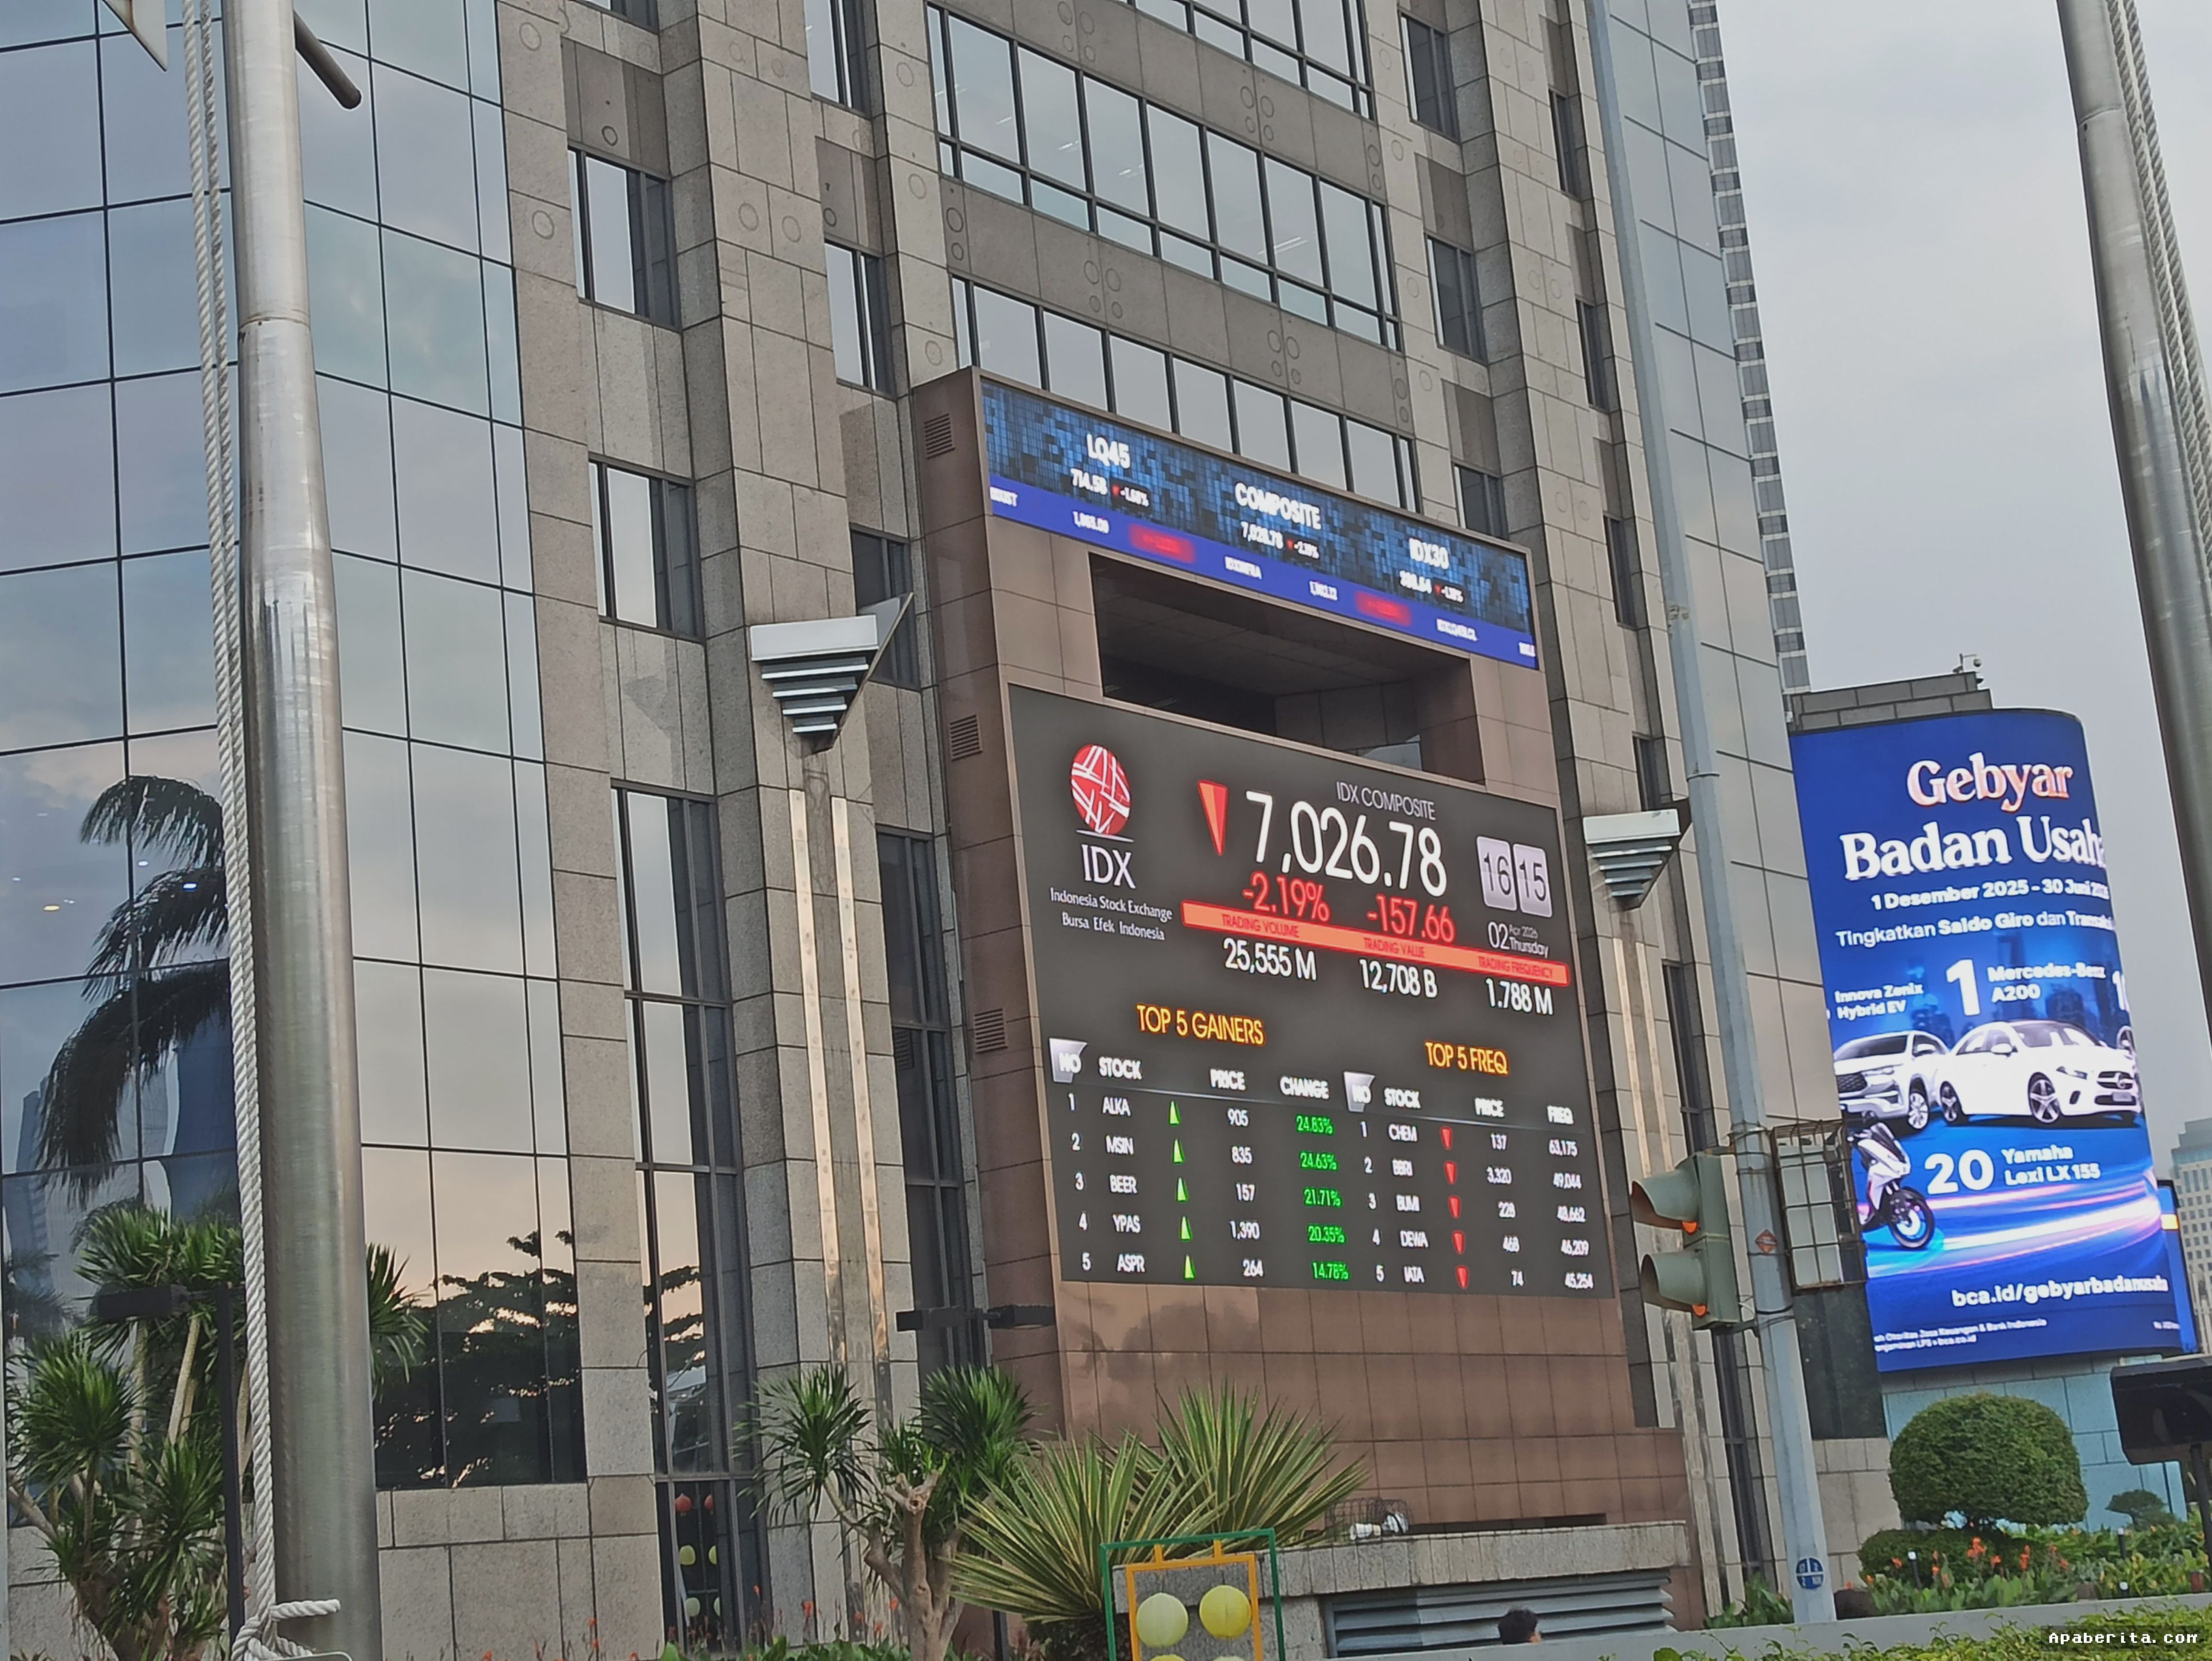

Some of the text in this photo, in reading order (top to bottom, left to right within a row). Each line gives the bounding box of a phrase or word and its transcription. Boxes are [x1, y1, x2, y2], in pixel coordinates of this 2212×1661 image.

[1087, 433, 1130, 469] LQ45
[1235, 483, 1321, 530] COMPOSITE
[1409, 538, 1449, 569] IDX30
[1907, 752, 2073, 812] Gebyar
[1337, 781, 1437, 821] IDX COMPOSITE
[1246, 790, 1448, 897] 7,026.78
[1839, 821, 2012, 881] Badan
[1082, 844, 1136, 889] IDX
[1483, 851, 1547, 902] 16 15
[1051, 887, 1172, 923] Indonesia Stock Exchange
[1242, 871, 1455, 943] -2.19% -157.66
[1870, 894, 1882, 910] 1
[1884, 886, 1980, 909] Desember
[1982, 879, 2029, 898] 2025
[2041, 878, 2064, 894] 30
[1062, 911, 1165, 941] Bursa Efek Indonesia
[1222, 913, 1299, 938] TRADING VOLUME
[1488, 921, 1510, 950] 02
[1835, 924, 1936, 948] Tingkatkan
[1937, 915, 1993, 936] Saldo
[1994, 910, 2034, 929] Giro
[2036, 911, 2066, 927] dan
[1224, 938, 1316, 981] 25,555 M
[1364, 937, 1426, 958] TRADING VALUE
[1509, 936, 1549, 959] Thursday
[1359, 959, 1438, 998] 12,708 B
[1478, 956, 1553, 978] TRADING FREQUENCY
[1485, 978, 1554, 1015] 1.788 M
[1835, 982, 1924, 1004] Innova Zenix
[1946, 959, 1980, 1017] 1
[1987, 962, 2106, 982] Mercedes-Benz
[1991, 983, 2041, 1003] A200
[1137, 1004, 1264, 1045] TOP 5 GAINERS
[1836, 1002, 1886, 1021] Hybrid
[1886, 999, 1907, 1014] EV
[1425, 1041, 1508, 1074] TOP 5 FREQ
[1059, 1052, 1330, 1099] NO STOCK PRICE CHANGE
[1068, 1093, 1333, 1134] 1 ALKA 905 24.83%
[1384, 1087, 1421, 1109] STOCK
[1475, 1097, 1504, 1118] PRICE
[1072, 1132, 1338, 1170] 2 MSIN 835 24.63%
[1360, 1121, 1368, 1138] 1
[1491, 1133, 1507, 1150] 137
[1364, 1156, 1373, 1174] 2
[1924, 1144, 2074, 1195] 20 Yamaha
[2004, 1162, 2101, 1186] Lexi LX 155
[1074, 1172, 1341, 1207] 3 BEER 157 21.71%
[1368, 1193, 1377, 1209] 3
[1078, 1212, 1345, 1243] 4 YPAS 1,390 20.35%
[1372, 1229, 1381, 1246] 4
[1400, 1230, 1429, 1248] DEWA
[1082, 1251, 1092, 1271] 5
[1117, 1253, 1146, 1273] ASPR
[1242, 1259, 1264, 1277] 264
[1376, 1264, 1384, 1283] 5
[1511, 1270, 1524, 1286] 74
